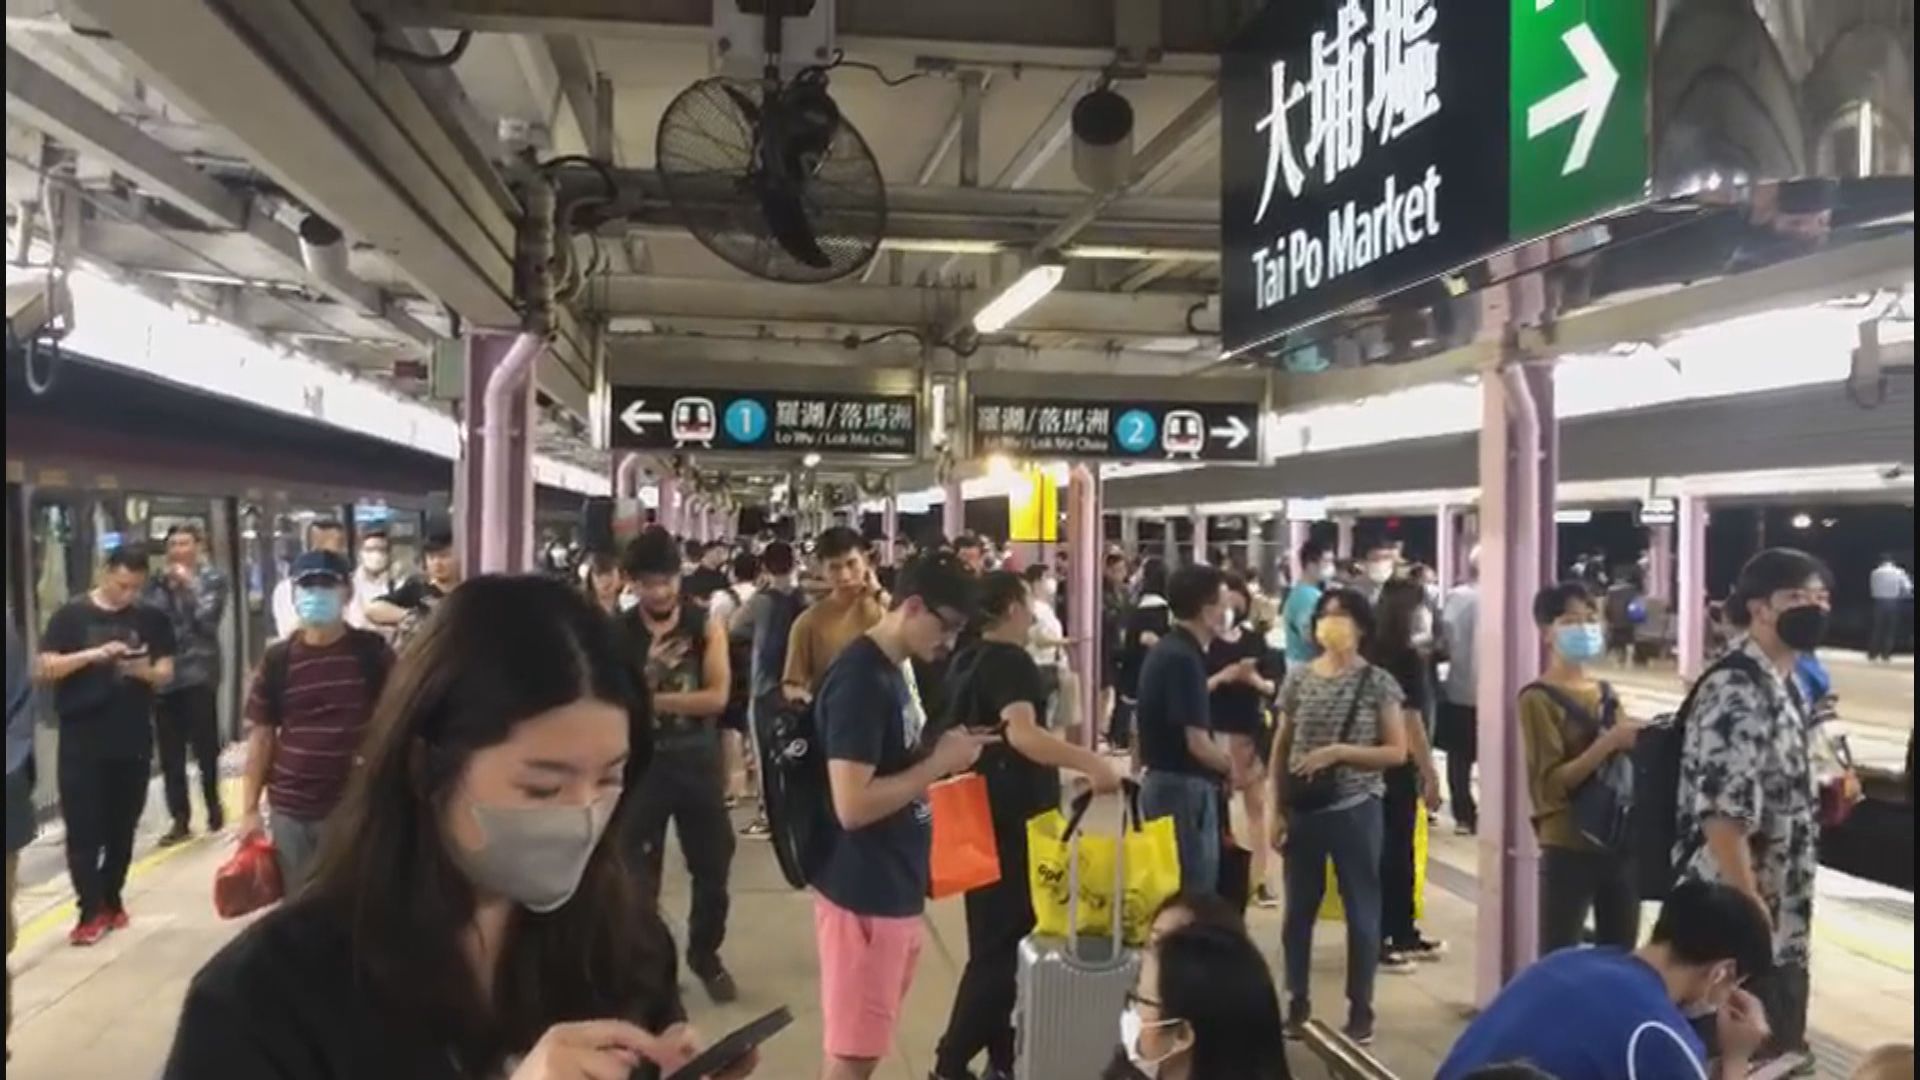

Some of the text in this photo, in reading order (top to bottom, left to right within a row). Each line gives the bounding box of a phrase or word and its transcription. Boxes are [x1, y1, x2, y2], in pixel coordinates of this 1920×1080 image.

[1254, 0, 1442, 224] 大埔墟
[1252, 164, 1442, 310] Tai Po Market
[740, 407, 750, 433] 1
[1126, 417, 1145, 443] 2
